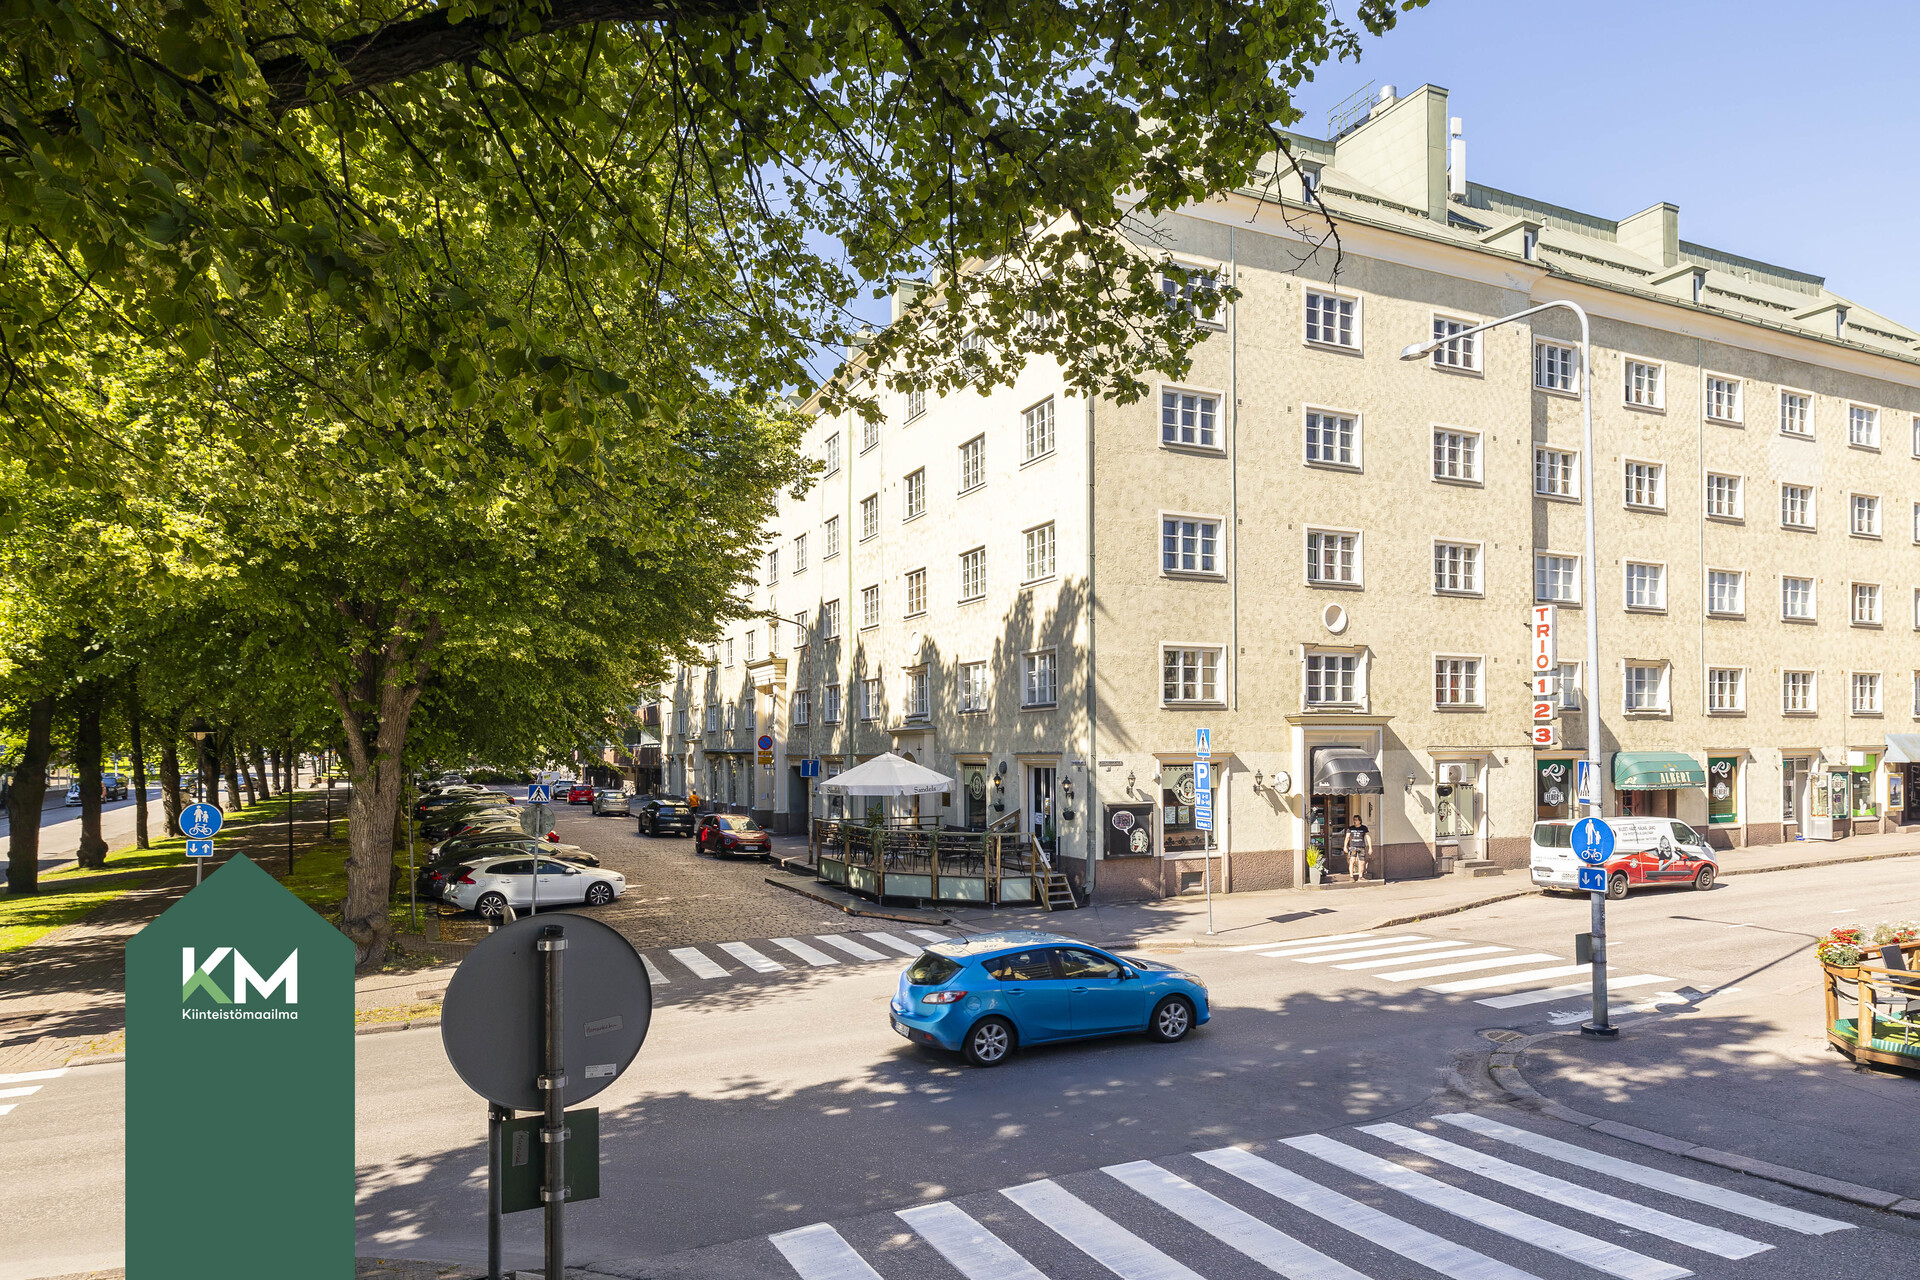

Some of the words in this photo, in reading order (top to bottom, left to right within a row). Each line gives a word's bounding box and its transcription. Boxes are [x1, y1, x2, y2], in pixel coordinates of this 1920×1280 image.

[1535, 607, 1550, 669] TRIO
[1537, 678, 1545, 693] 1
[1534, 703, 1550, 718] 2
[1535, 727, 1551, 743] 3
[1197, 763, 1208, 788] P
[1660, 771, 1691, 783] ALBERT
[914, 785, 937, 793] Sandels
